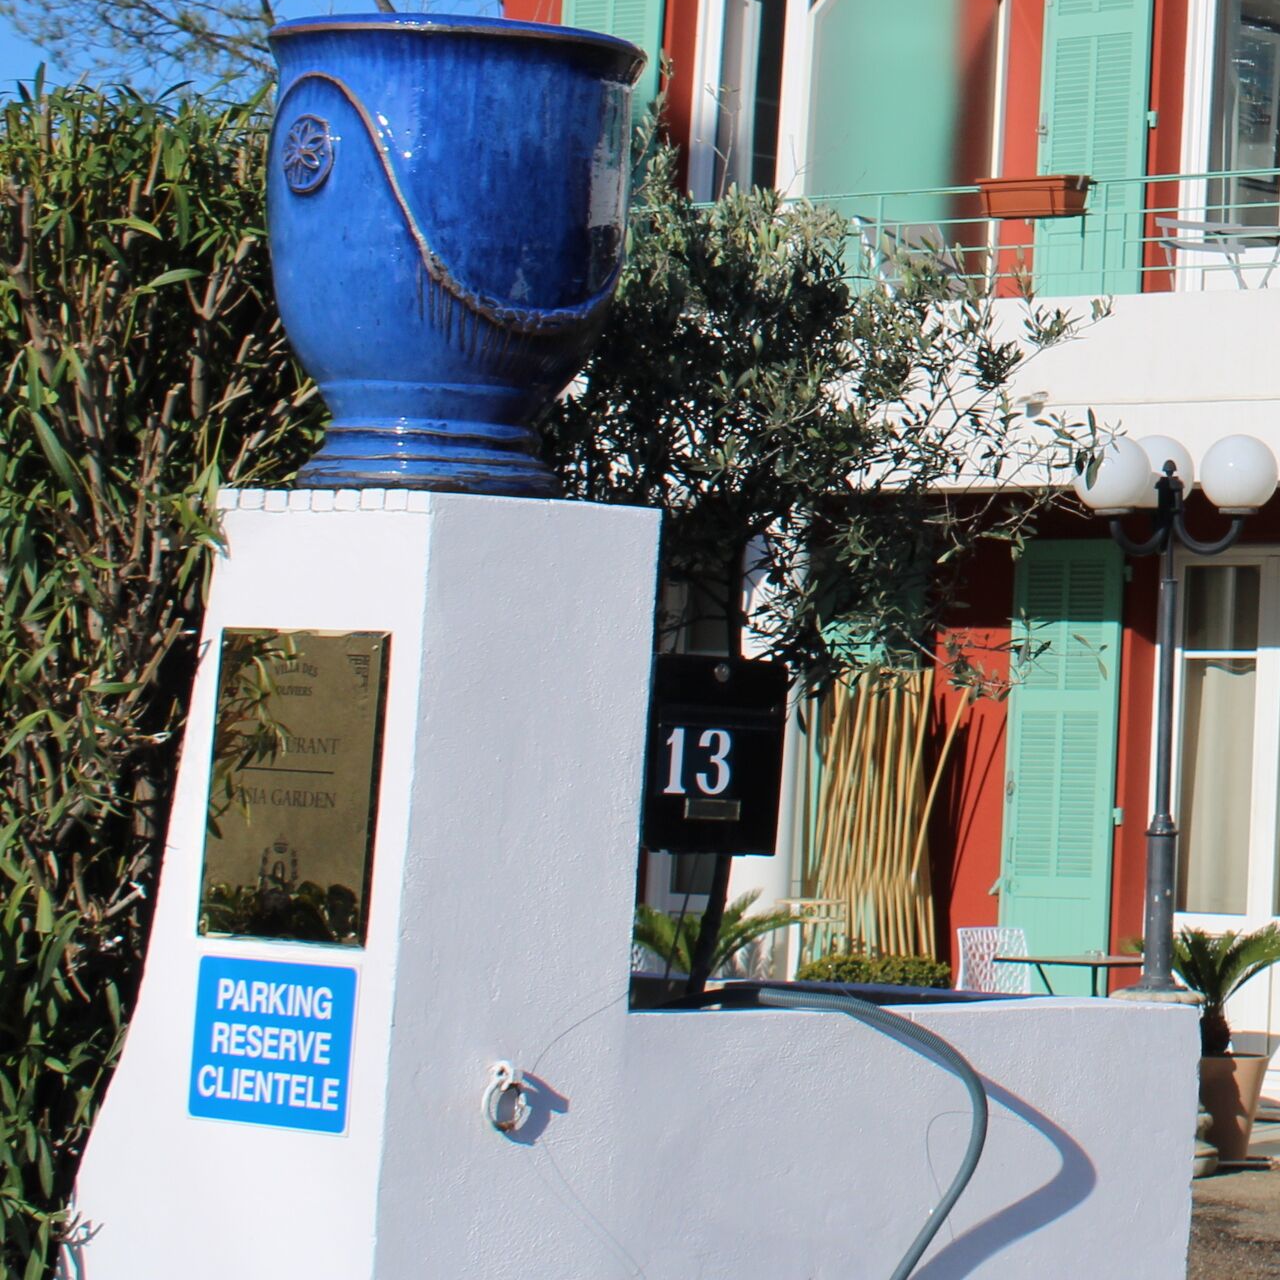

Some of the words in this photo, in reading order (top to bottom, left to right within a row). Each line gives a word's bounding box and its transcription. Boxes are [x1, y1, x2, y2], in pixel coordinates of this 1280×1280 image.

[663, 727, 732, 795] 13
[270, 787, 337, 809] GARDEN
[216, 978, 333, 1020] PARKING
[211, 1022, 332, 1065] RESERVE
[197, 1064, 340, 1111] CLIENTELE
